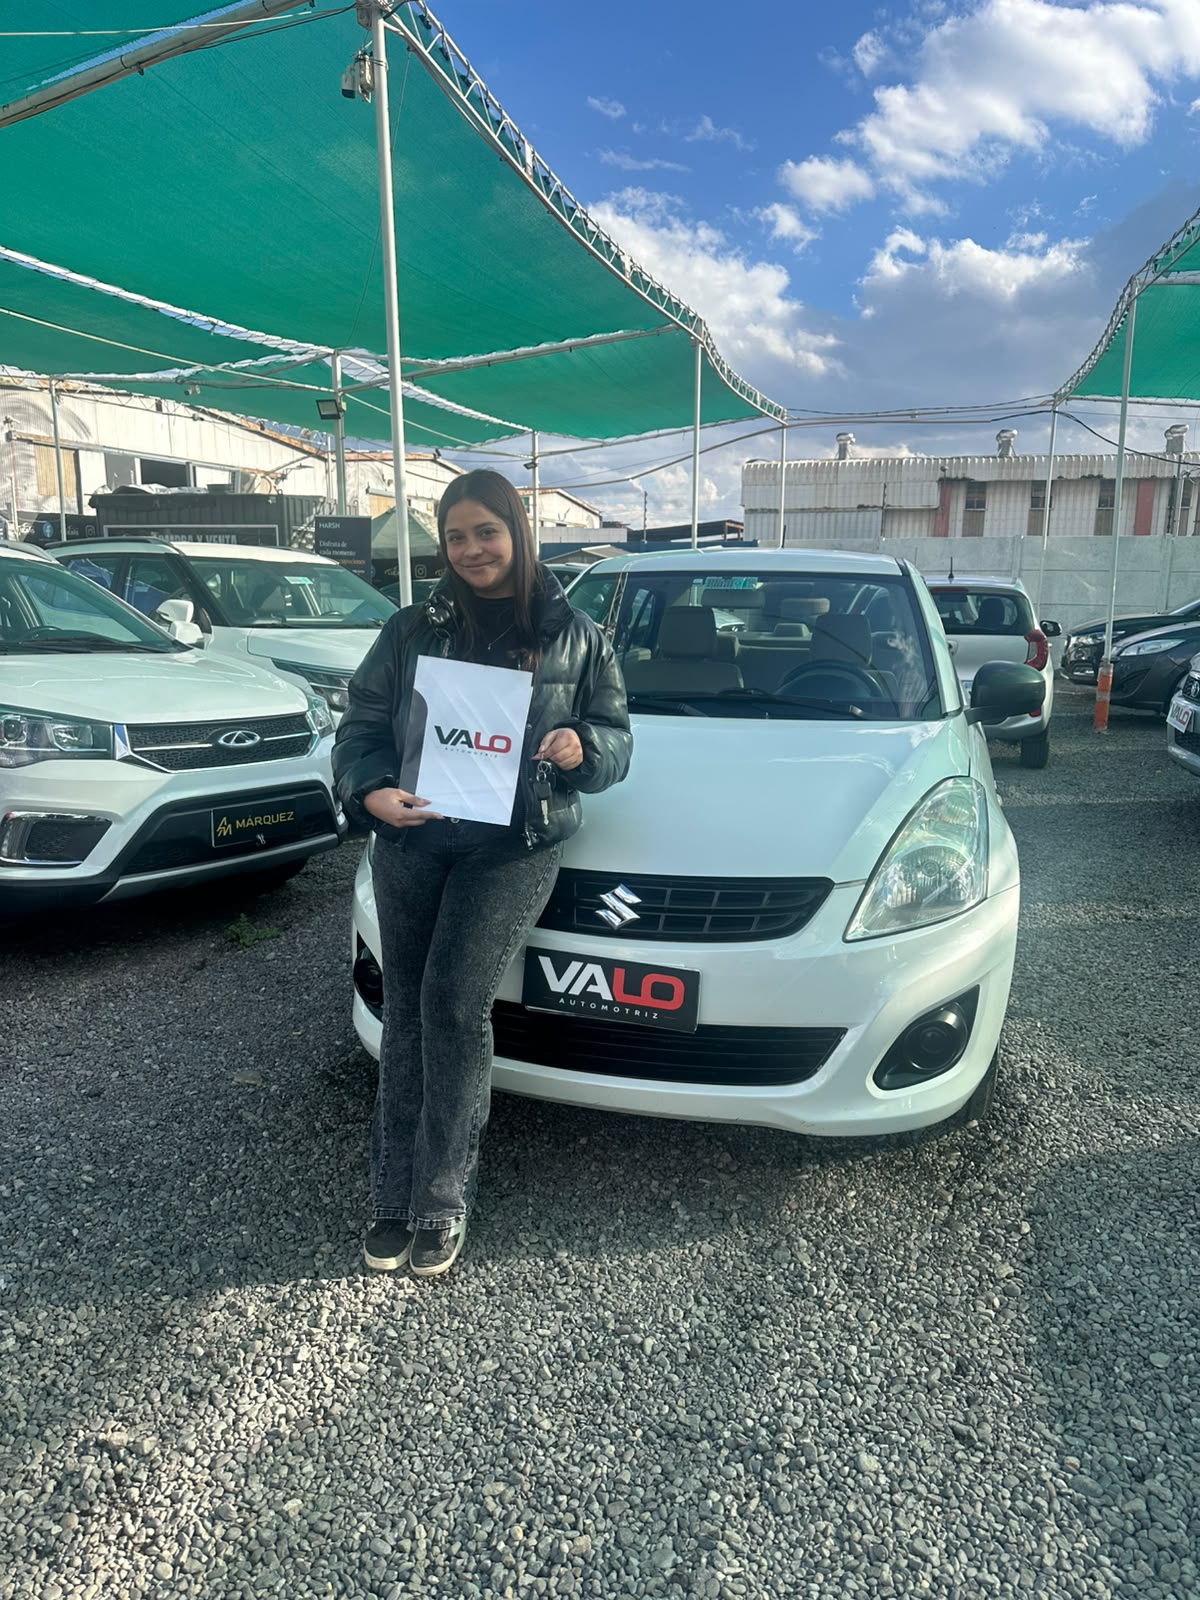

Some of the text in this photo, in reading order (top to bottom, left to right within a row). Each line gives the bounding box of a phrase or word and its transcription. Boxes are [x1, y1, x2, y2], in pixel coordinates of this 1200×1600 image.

[206, 534, 238, 545] VENTA
[434, 725, 512, 754] VALO
[538, 955, 685, 1011] VALO
[559, 997, 659, 1020] AUTOMOTRIZ
